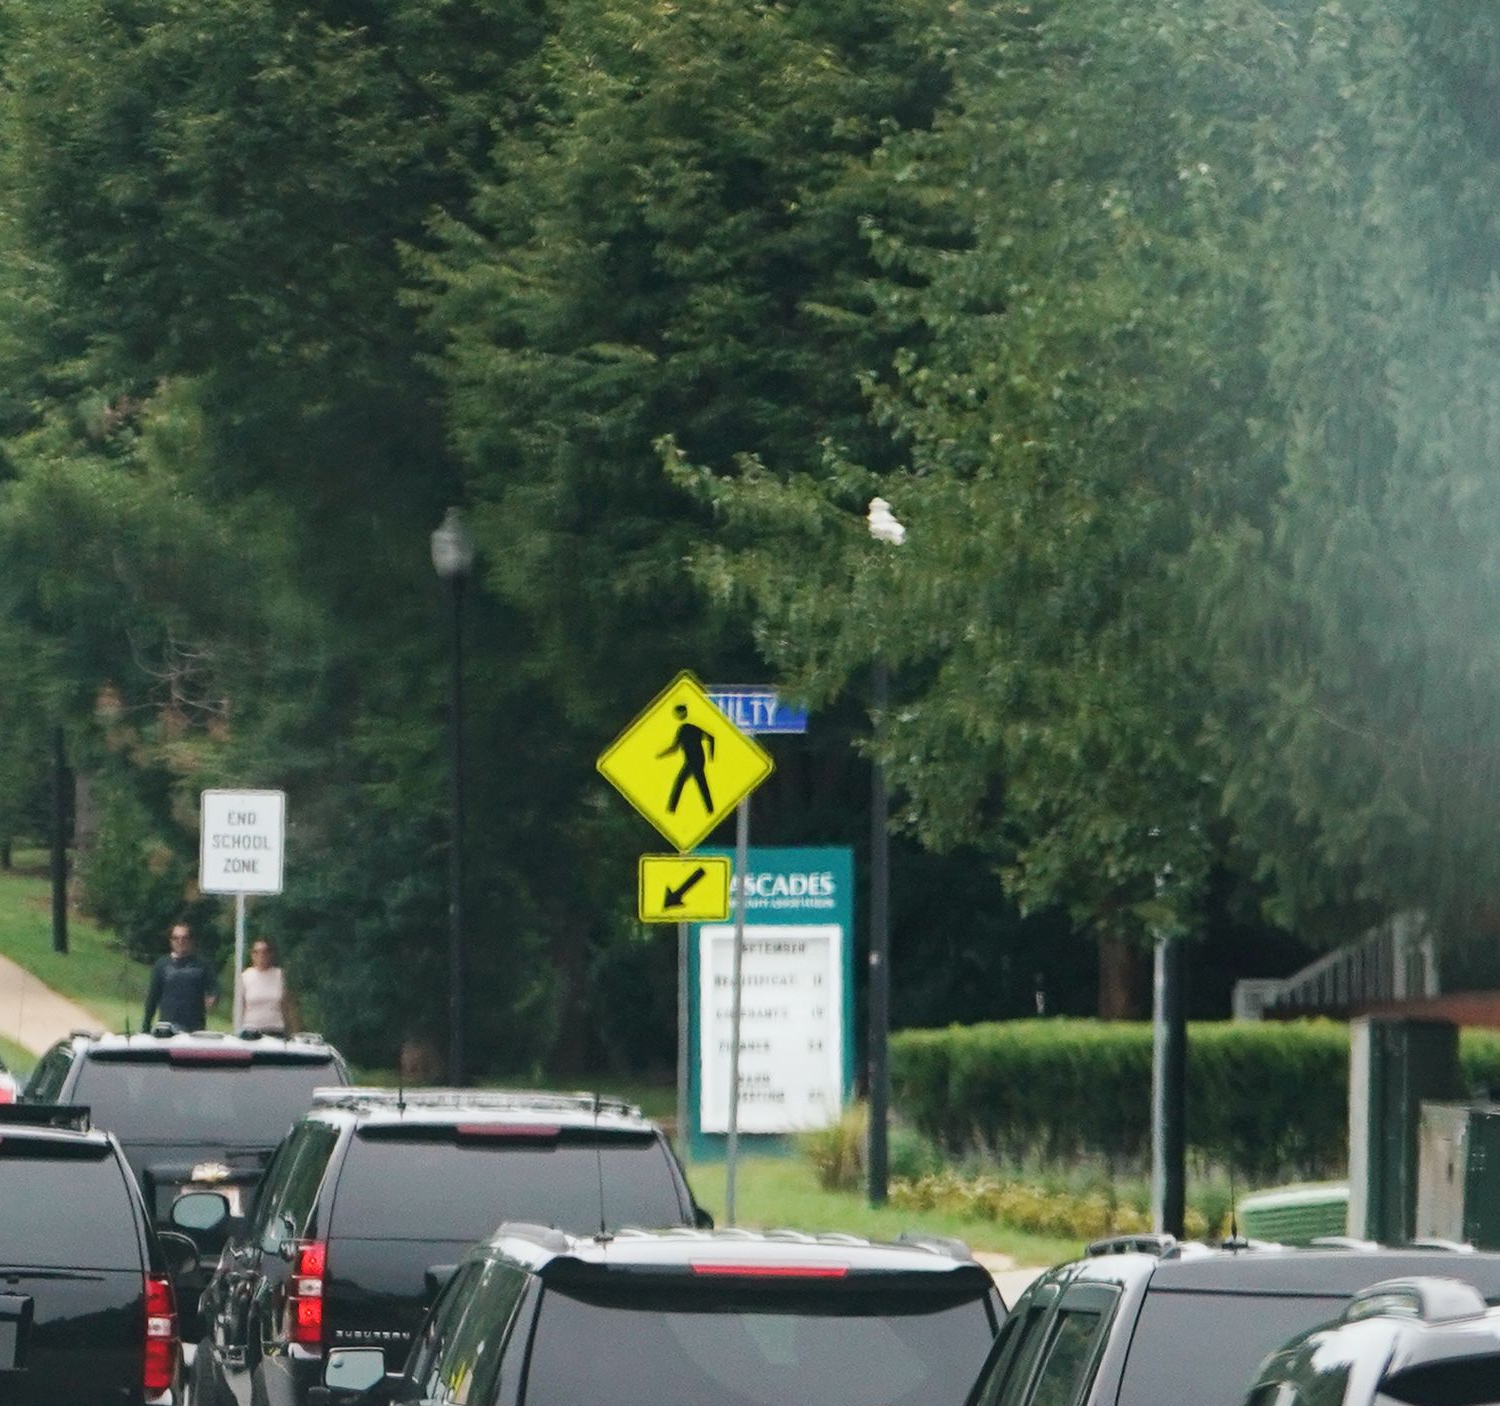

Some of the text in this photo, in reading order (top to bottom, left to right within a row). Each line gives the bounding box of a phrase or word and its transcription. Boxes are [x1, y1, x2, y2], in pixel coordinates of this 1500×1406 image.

[227, 811, 257, 826] END
[212, 834, 271, 850] SCHOOL
[223, 858, 259, 874] ZONE
[730, 872, 835, 896] SCADES
